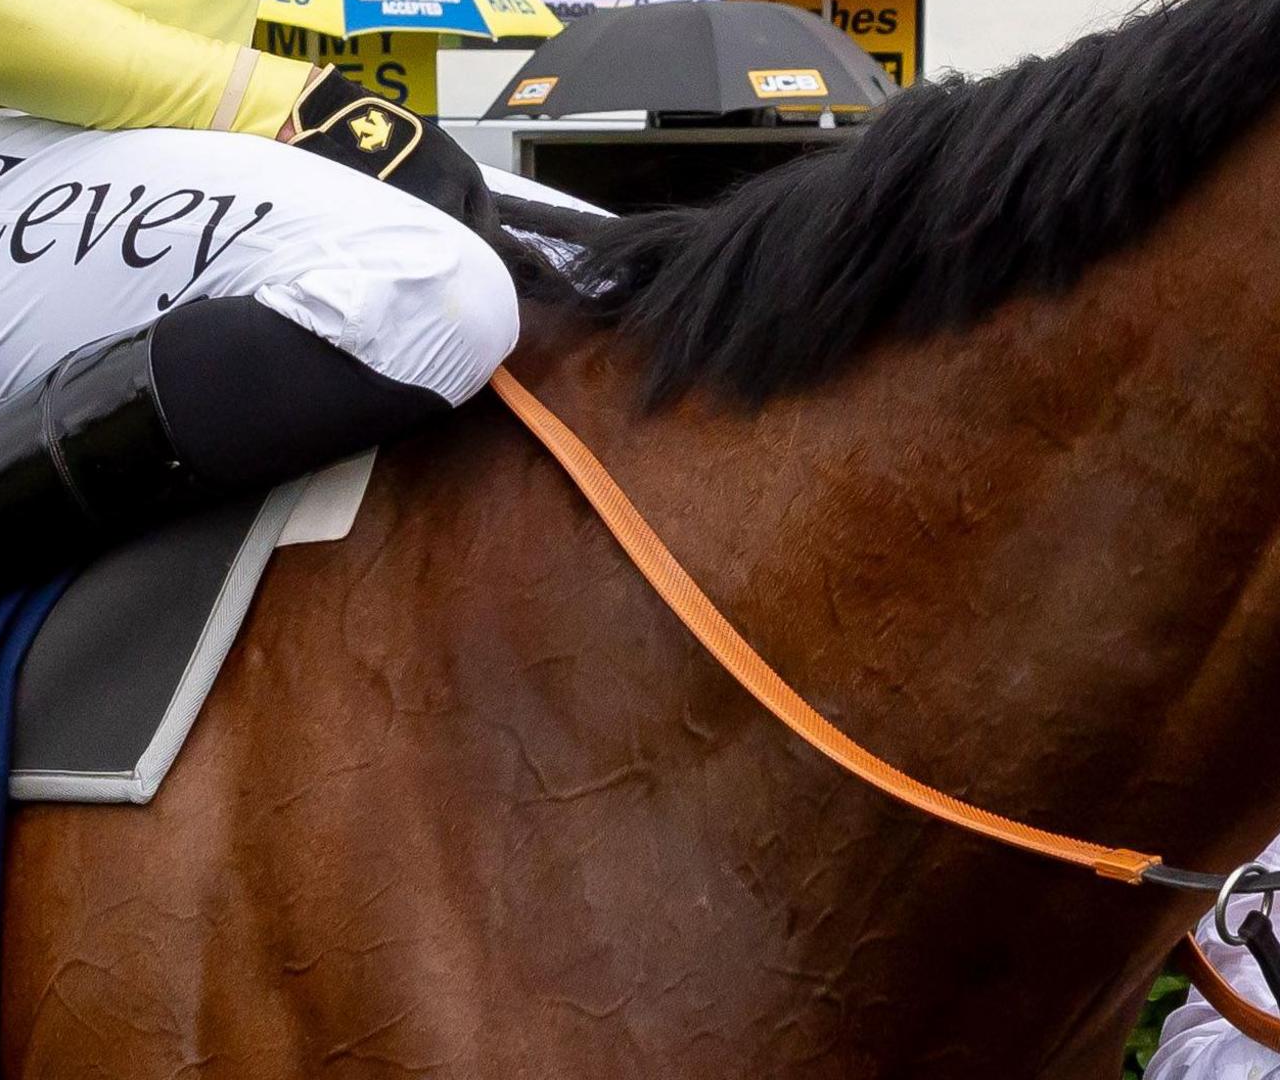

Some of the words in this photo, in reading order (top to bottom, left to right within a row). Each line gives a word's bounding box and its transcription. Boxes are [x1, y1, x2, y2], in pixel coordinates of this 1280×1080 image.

[381, 0, 443, 16] ACCEPTED
[831, 0, 897, 35] hes
[761, 74, 819, 92] JCB
